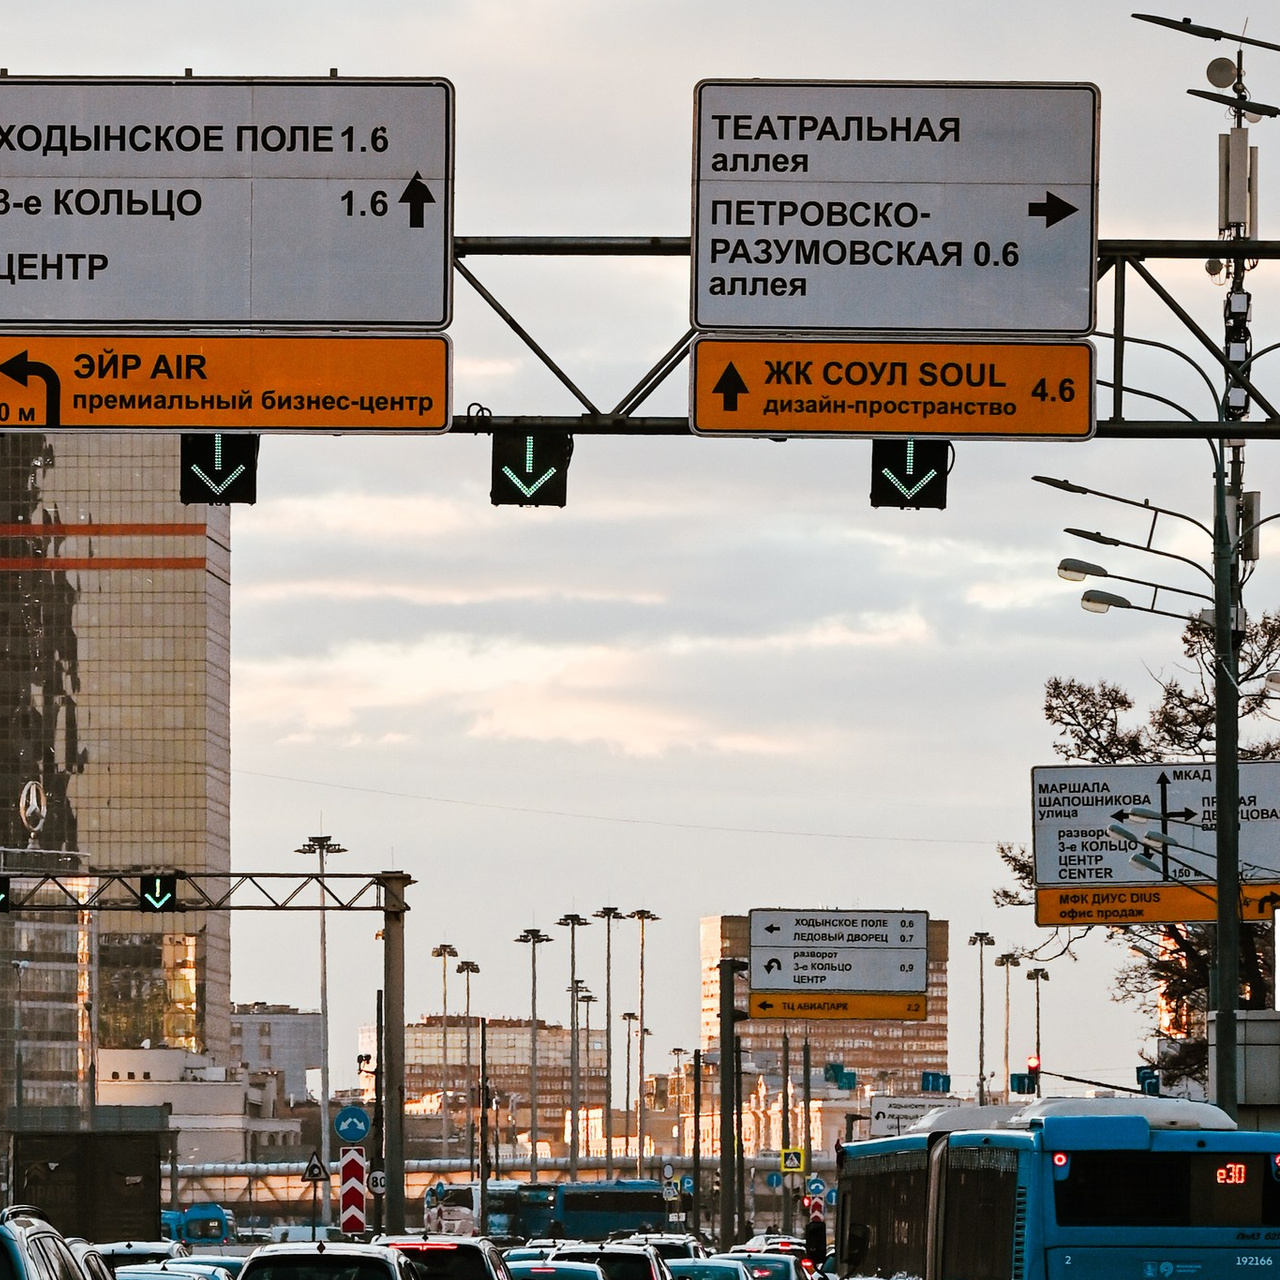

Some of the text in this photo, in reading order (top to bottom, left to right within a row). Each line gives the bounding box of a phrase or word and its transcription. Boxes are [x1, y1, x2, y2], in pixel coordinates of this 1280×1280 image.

[712, 115, 959, 142] ТЕАТРАЛЬНАЯ
[237, 126, 333, 152] ПОЛЕ
[341, 126, 388, 152] 1.6
[712, 153, 808, 172] аллея
[55, 189, 201, 221] КОЛЬЦО
[341, 191, 387, 216] 1.6
[712, 200, 930, 227] ПЕТРОВСКО-
[711, 239, 1019, 266] РАЗУМОВСКАЯ 0.6
[709, 277, 806, 296] аллея
[74, 349, 207, 379] ЭЙР AIR
[765, 361, 1074, 402] ЖК СОУЛ SOUL 4.6
[74, 390, 432, 416] премиальный бизнес-центр
[764, 395, 1016, 418] дизайн-пространство
[1172, 769, 1212, 782] МКАД
[1038, 782, 1111, 794] МАРШАЛА
[1038, 794, 1152, 808] ШАПОШНИКОВА
[1038, 809, 1079, 821] улица
[1058, 829, 1111, 840] развор
[1081, 840, 1138, 853] КОЛЬЦО
[1058, 855, 1104, 867] ЦЕНТР
[1058, 868, 1113, 880] CENTER
[1059, 893, 1161, 906] МФК ДИУС DIUS
[1059, 908, 1144, 921] офис продаж
[794, 918, 914, 928] ХОДЫНСКОЕ ПОЛЕ 0.6
[793, 932, 914, 943] ЛЕДОВЫЙ ДВОРЕЦ 0.7
[793, 951, 838, 960] разворот
[811, 963, 852, 972] КОЛЬЦО
[793, 975, 826, 985] ЦЕНТР
[797, 1001, 848, 1011] АВИАПАРК
[1216, 1163, 1246, 1184] e30
[372, 1176, 385, 1188] 80
[1065, 1256, 1072, 1265] 2
[1236, 1256, 1273, 1266] 192166
